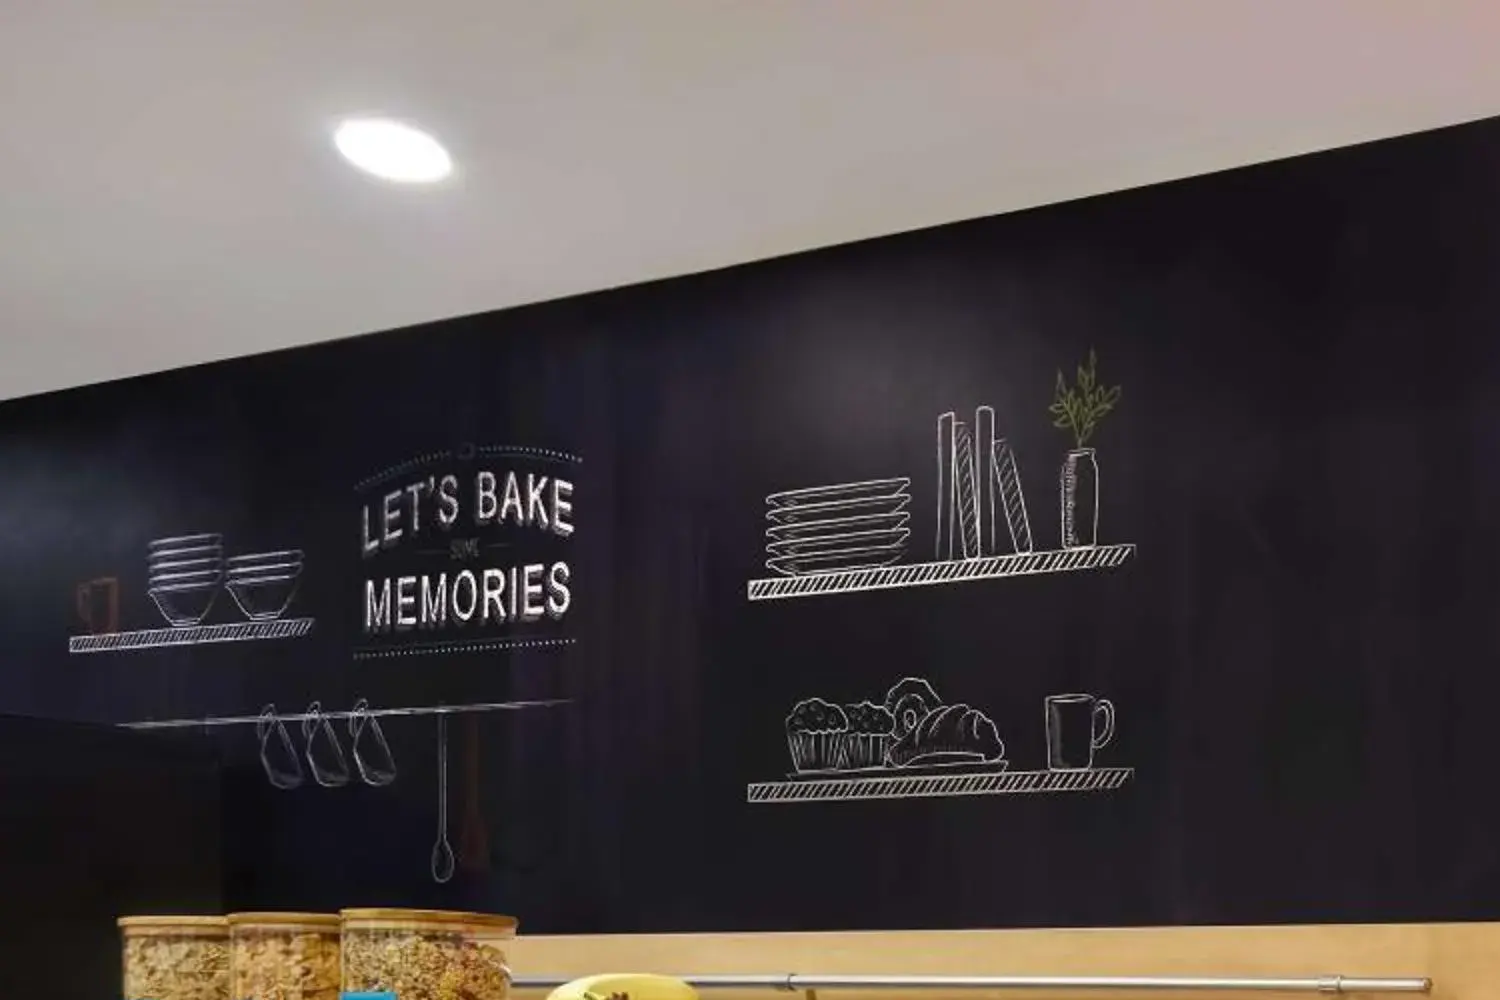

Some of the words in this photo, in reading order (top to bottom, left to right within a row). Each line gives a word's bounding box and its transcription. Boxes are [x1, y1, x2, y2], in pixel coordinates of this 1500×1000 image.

[361, 473, 460, 556] LET'S
[474, 470, 576, 537] BAKE
[364, 561, 572, 632] MEMORIES
